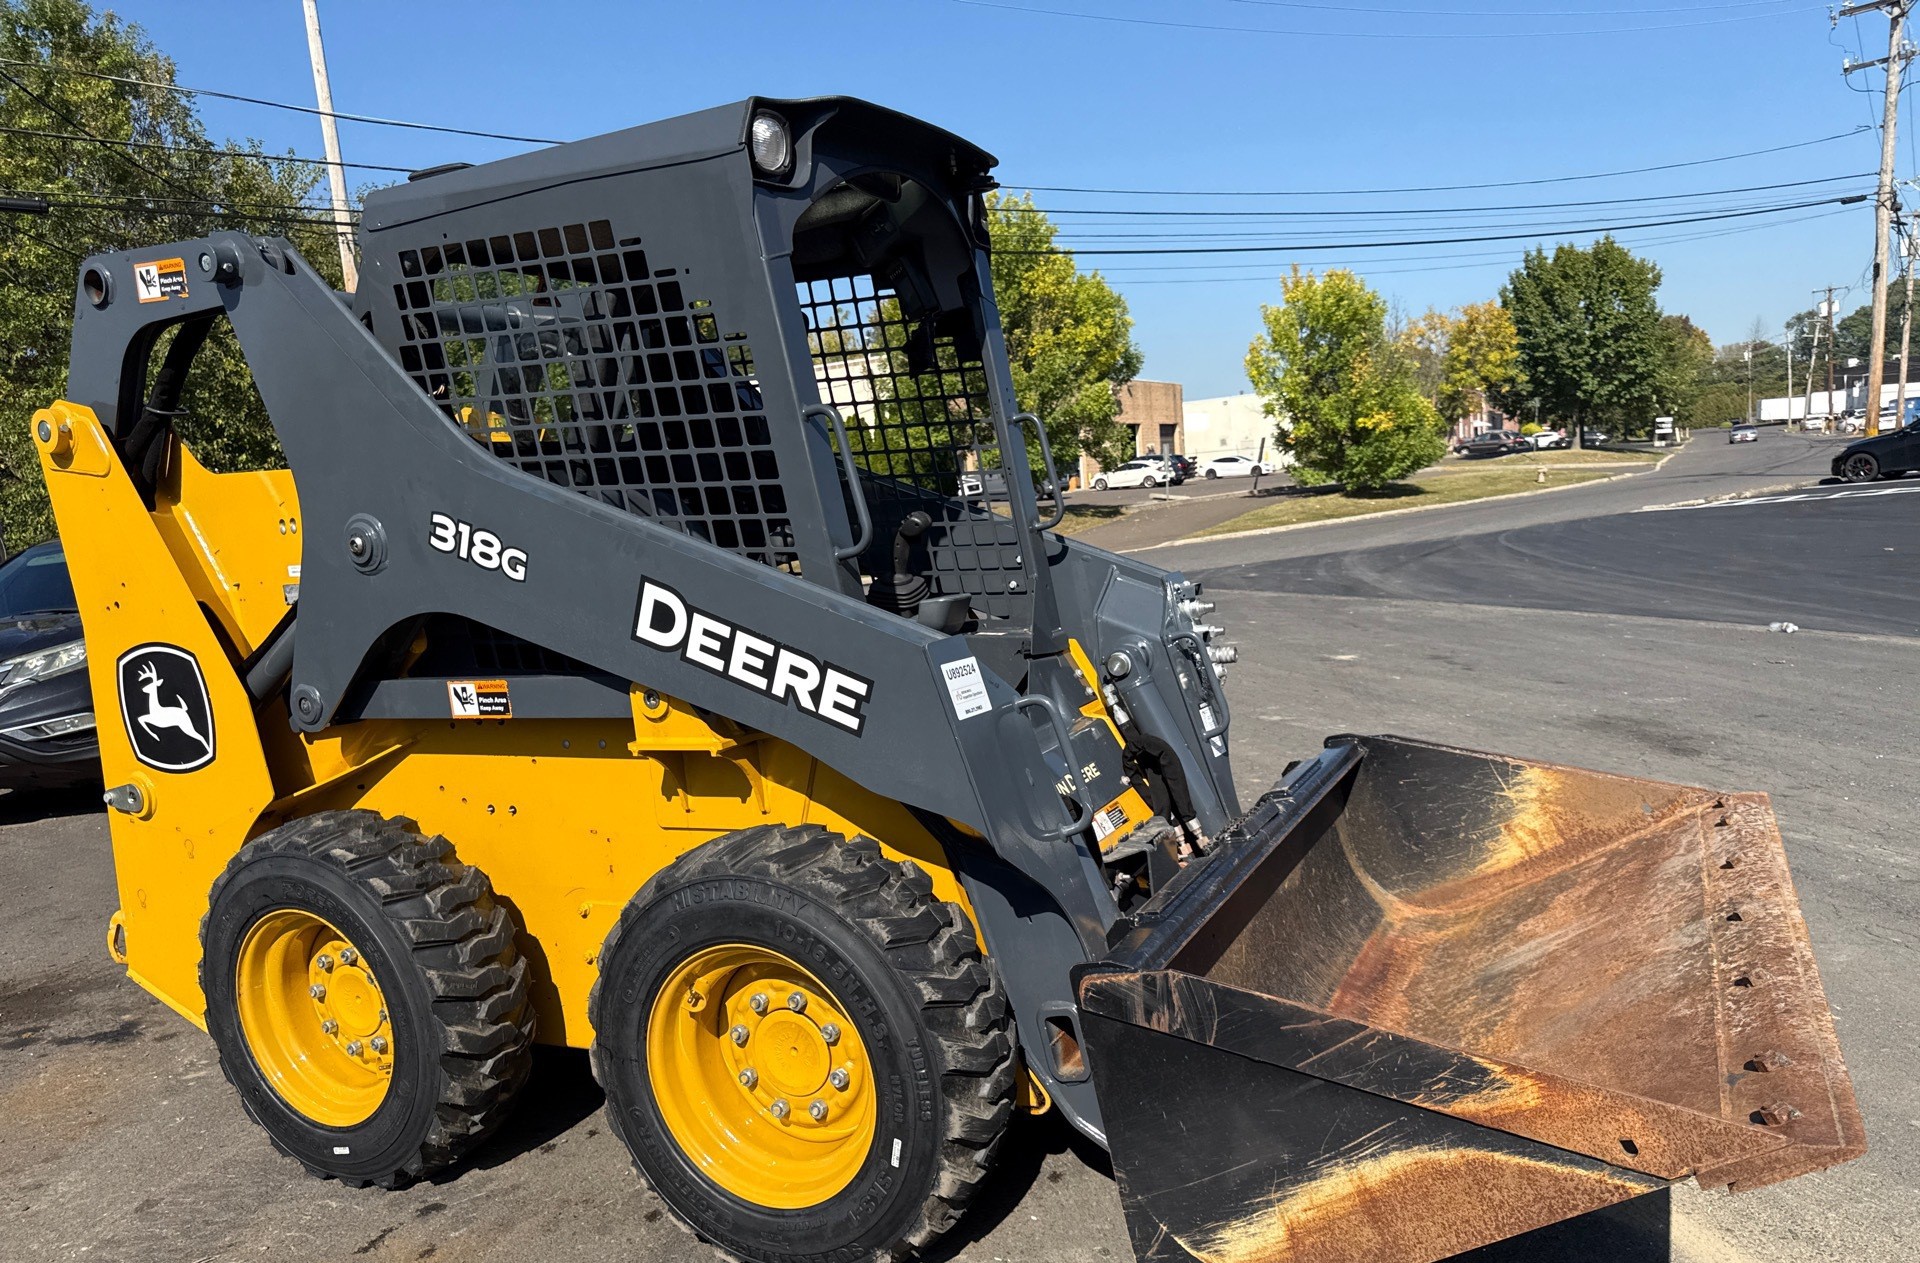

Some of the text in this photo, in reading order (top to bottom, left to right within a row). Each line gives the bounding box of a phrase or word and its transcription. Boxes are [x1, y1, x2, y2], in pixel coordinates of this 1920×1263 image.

[430, 513, 527, 582] 318G
[635, 580, 869, 731] DEERE
[946, 663, 976, 681] U892524
[1064, 763, 1100, 791] DERE
[890, 1074, 904, 1122] NYLON
[907, 1037, 932, 1121] TUBELESS
